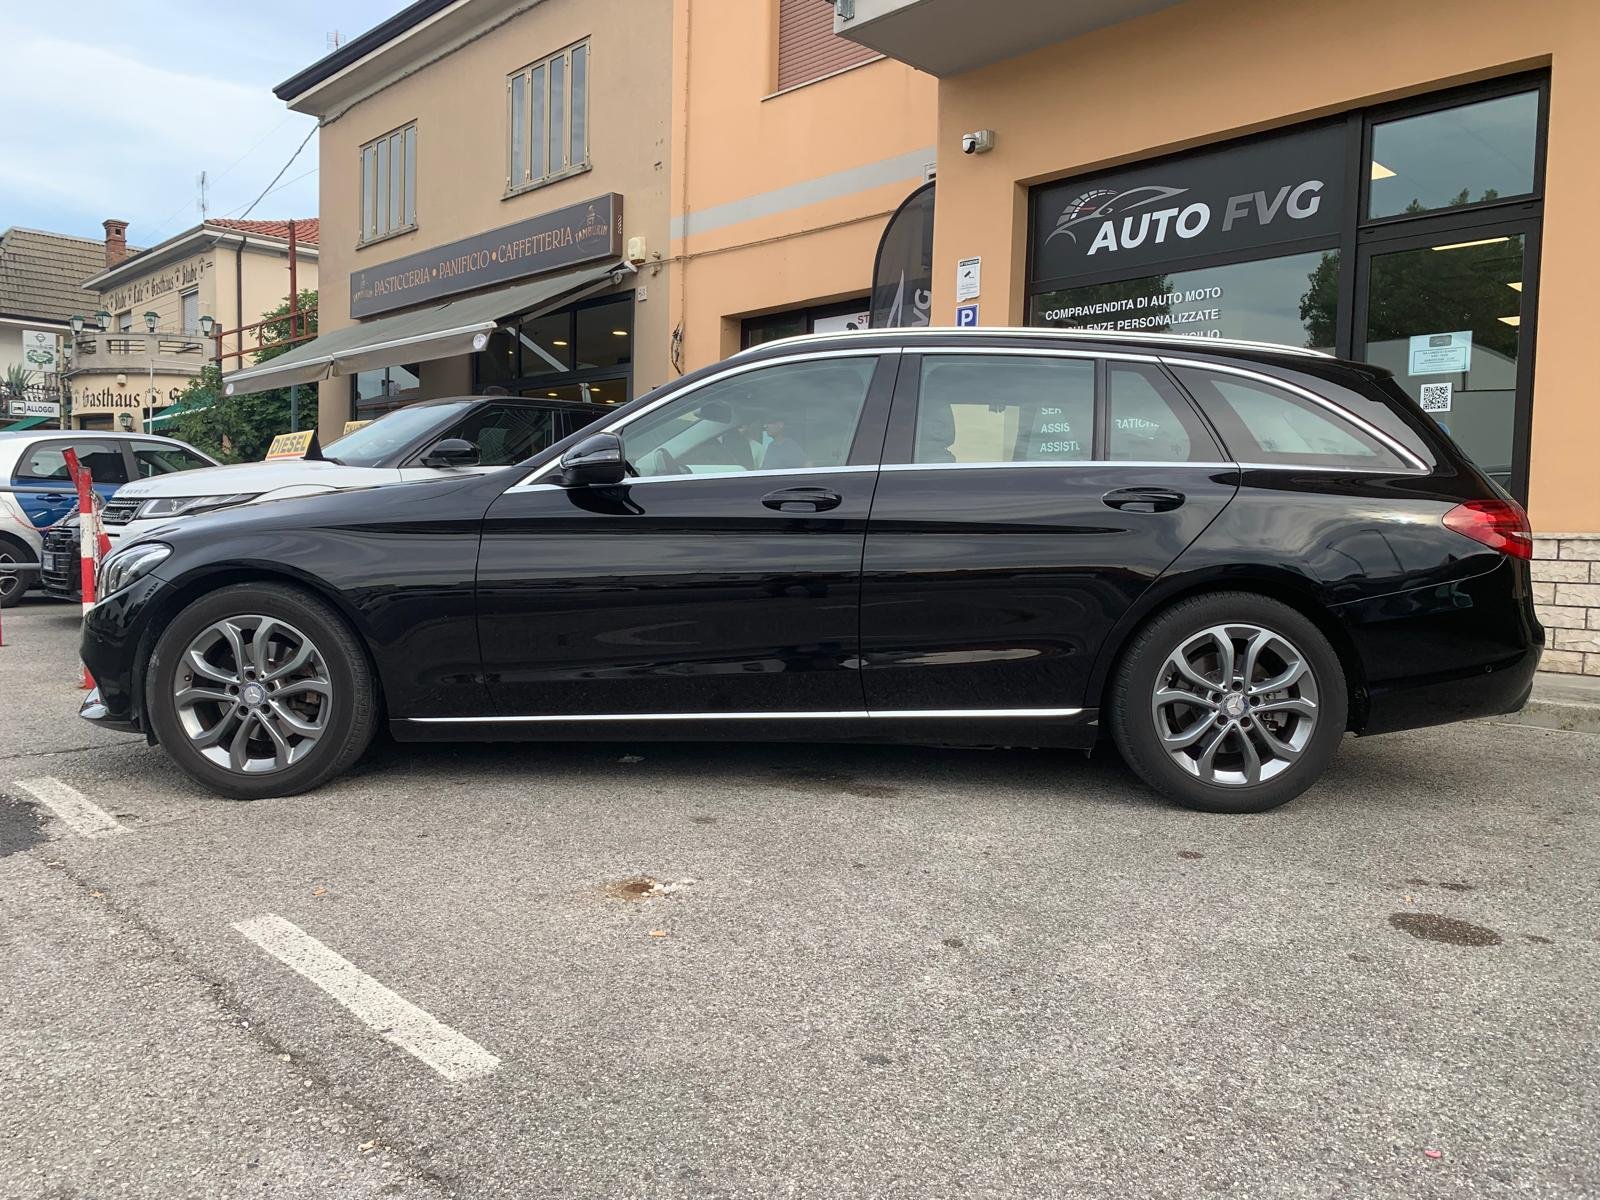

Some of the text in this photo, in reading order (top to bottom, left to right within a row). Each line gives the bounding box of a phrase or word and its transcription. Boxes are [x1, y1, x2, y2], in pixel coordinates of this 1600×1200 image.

[1087, 180, 1325, 256] AUTO FVG
[374, 267, 430, 297] PASTICCERIA
[439, 249, 490, 279] PANIFICIO
[498, 226, 573, 263] CAFFETTERIA
[1045, 286, 1221, 321] COMPRAVENDITA DI AUTO MOTO
[961, 309, 974, 327] P
[1117, 308, 1220, 331] PERSONALIZZATE
[82, 387, 140, 408] Gasthaus
[26, 405, 55, 414] ALLOGGI
[269, 434, 308, 454] DIESEL
